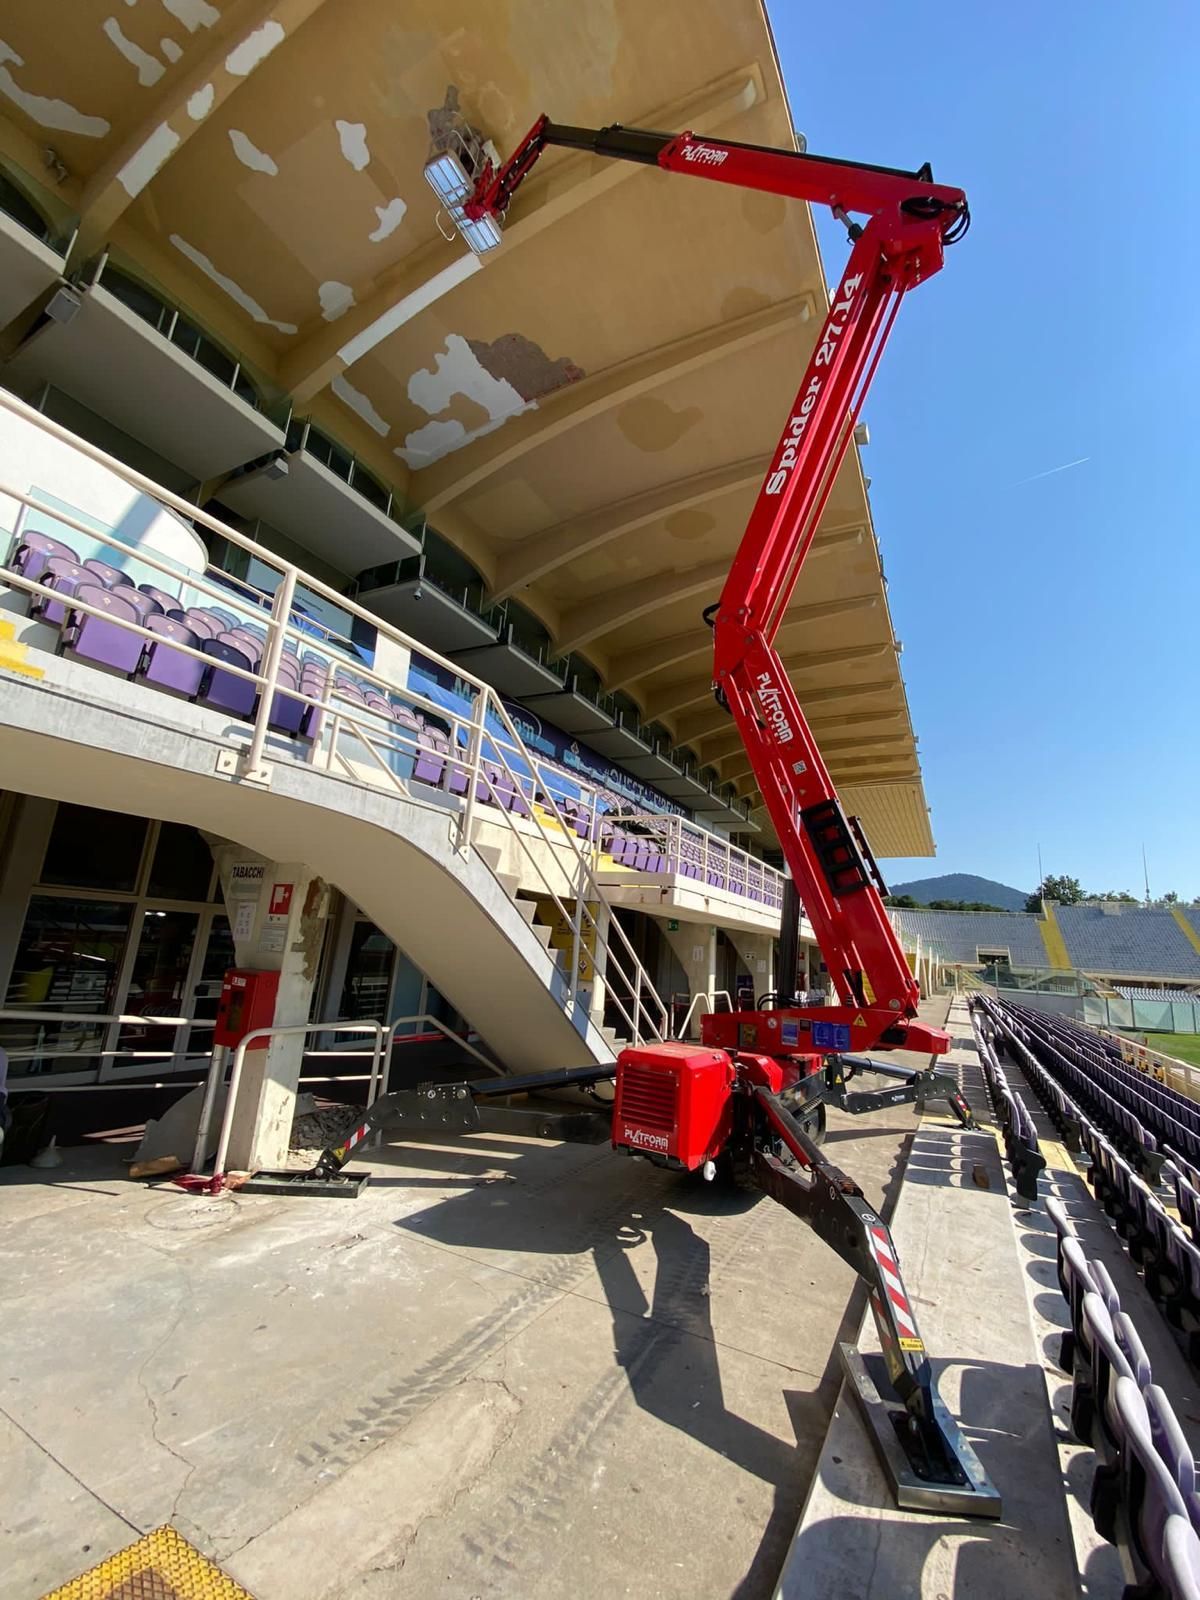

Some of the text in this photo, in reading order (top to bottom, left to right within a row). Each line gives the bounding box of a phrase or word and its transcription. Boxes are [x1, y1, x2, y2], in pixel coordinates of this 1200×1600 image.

[681, 144, 729, 163] PLATFORM
[765, 272, 864, 495] Spider 27.14
[757, 672, 793, 743] PLATFORM
[232, 866, 264, 878] TABACCHI
[624, 1129, 669, 1147] PLATFORM
